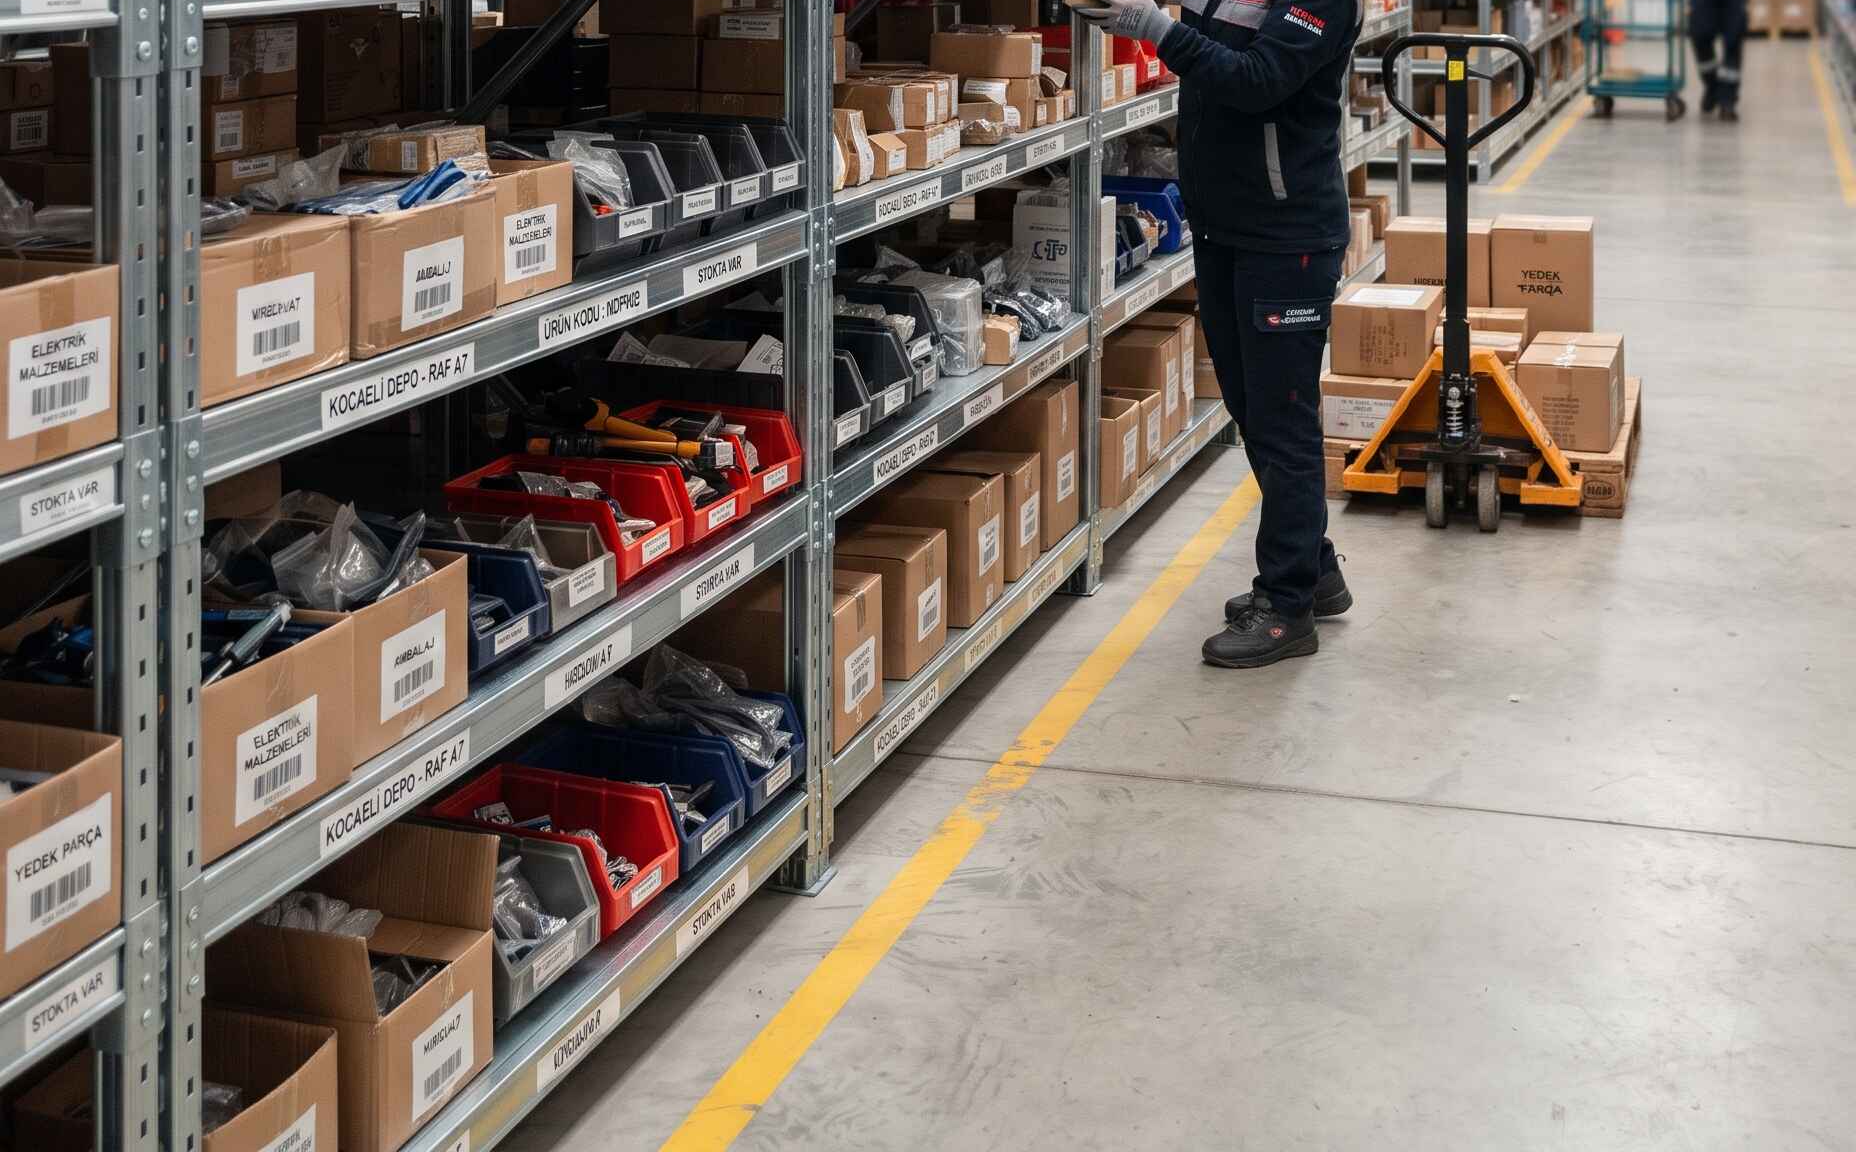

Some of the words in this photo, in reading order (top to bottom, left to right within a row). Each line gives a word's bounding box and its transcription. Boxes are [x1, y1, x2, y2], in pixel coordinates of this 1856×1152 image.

[698, 260, 728, 284] STOKTA
[728, 254, 742, 272] VAR
[32, 331, 87, 359] ELEKTRİK
[543, 315, 572, 341] ÜRÜN
[19, 348, 99, 382] MALZEMELERİ
[328, 379, 386, 419] KOCAELİ
[387, 369, 419, 398] DEPO
[428, 359, 451, 383] RAF
[455, 352, 470, 374] A7
[31, 491, 76, 517] STOKTA
[244, 723, 312, 771] MALZEMELERİ
[326, 793, 381, 846] KOCAELİ
[383, 774, 416, 810] DEPO
[425, 755, 449, 783] RAF
[449, 739, 466, 765] A7
[15, 848, 58, 883] YEDEK
[62, 825, 103, 857] PARÇA
[31, 991, 79, 1034] STOKTA
[81, 972, 104, 999] VAR
